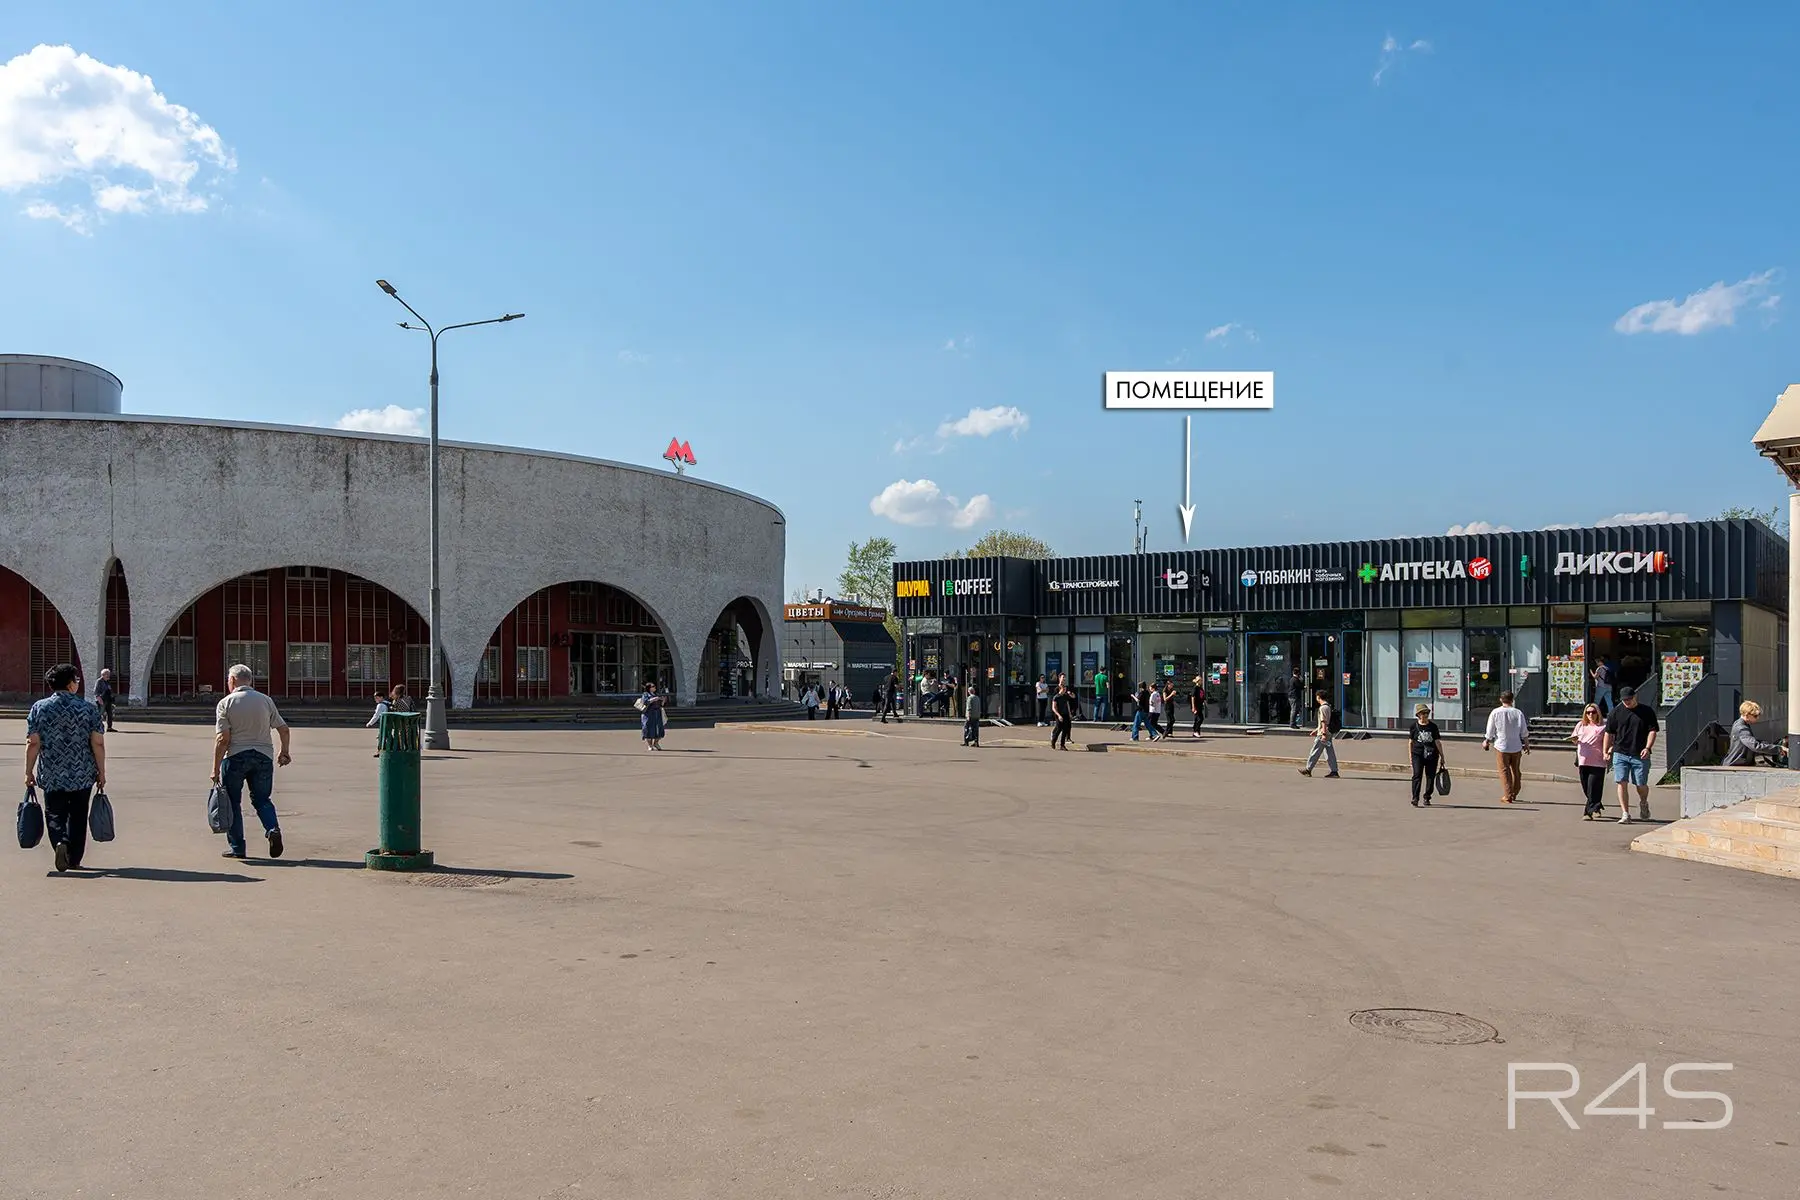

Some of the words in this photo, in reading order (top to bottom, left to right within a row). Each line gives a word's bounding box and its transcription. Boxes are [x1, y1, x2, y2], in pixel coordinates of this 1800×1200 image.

[1380, 560, 1466, 581] АПТЕКА
[1554, 551, 1654, 576] ДИКСИ
[1258, 568, 1311, 585] ТАБАКИН
[896, 580, 930, 597] ШАУРМА
[955, 578, 992, 595] COFFEE
[788, 607, 824, 617] ЦВЕТЫ
